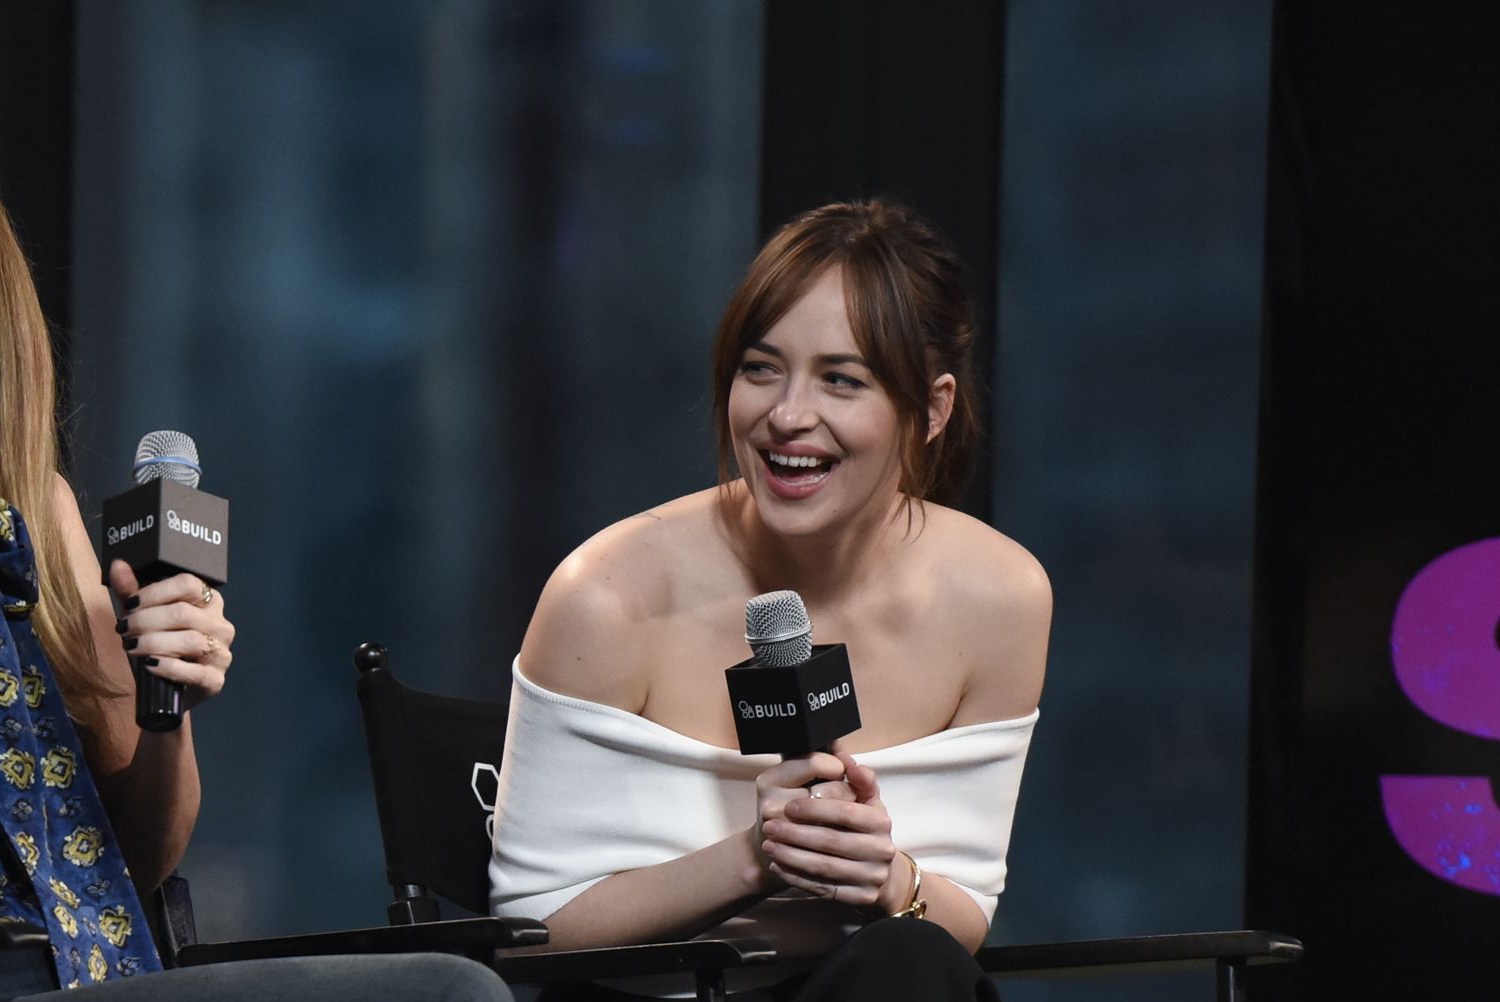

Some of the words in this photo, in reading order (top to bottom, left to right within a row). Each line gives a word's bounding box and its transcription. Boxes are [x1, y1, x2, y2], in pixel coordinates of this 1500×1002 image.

[120, 515, 154, 540] BUILD
[181, 520, 222, 545] BUILD
[820, 682, 850, 706] BUILD
[755, 703, 797, 718] BUILD
